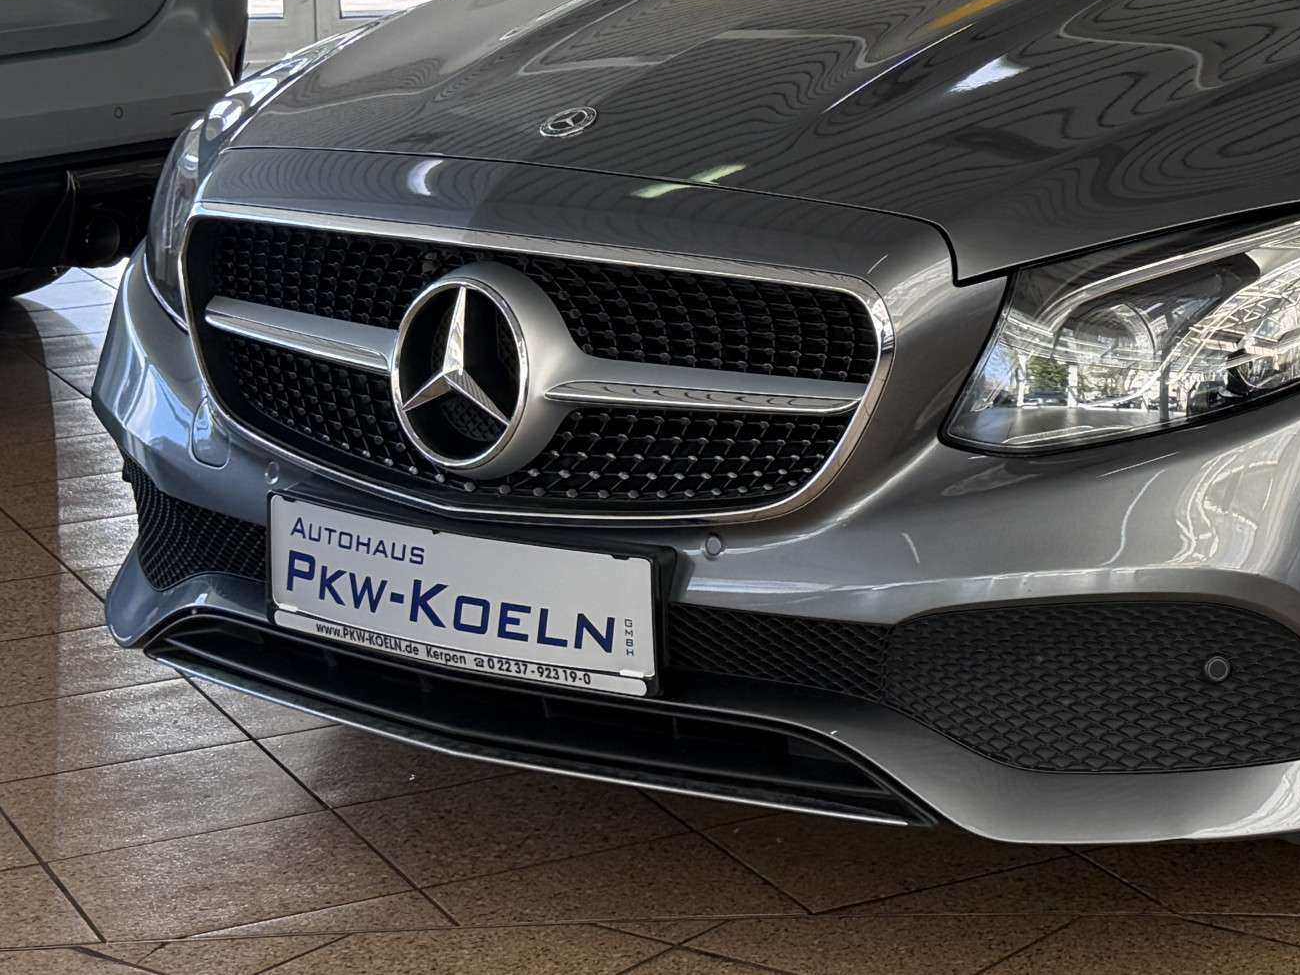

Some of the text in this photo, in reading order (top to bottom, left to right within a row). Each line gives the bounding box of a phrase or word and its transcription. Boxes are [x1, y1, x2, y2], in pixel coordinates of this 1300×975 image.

[290, 516, 425, 565] AUTOHAUS
[286, 549, 616, 653] PKW-KOELN
[316, 622, 420, 656] www.PKW-KOELN.de
[425, 645, 467, 666] Kerpen
